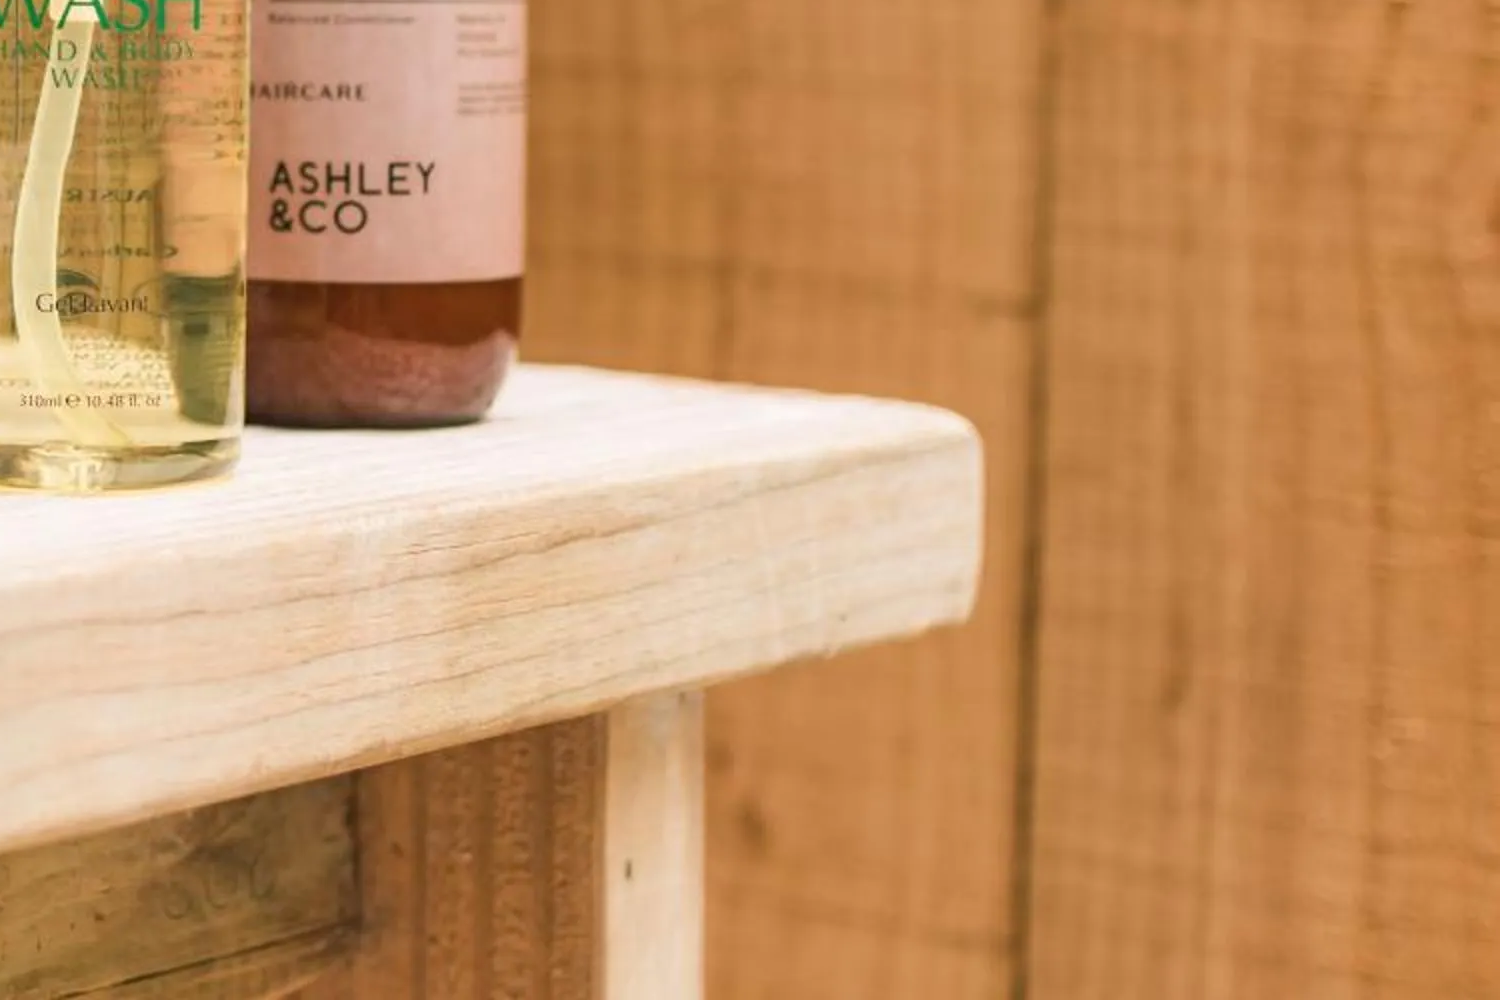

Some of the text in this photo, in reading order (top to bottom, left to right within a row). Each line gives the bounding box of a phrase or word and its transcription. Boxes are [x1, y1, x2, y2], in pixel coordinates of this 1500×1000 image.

[90, 40, 110, 61] &
[268, 160, 436, 196] ASHLEY
[268, 198, 369, 234] &CO
[19, 393, 62, 409] 310ml
